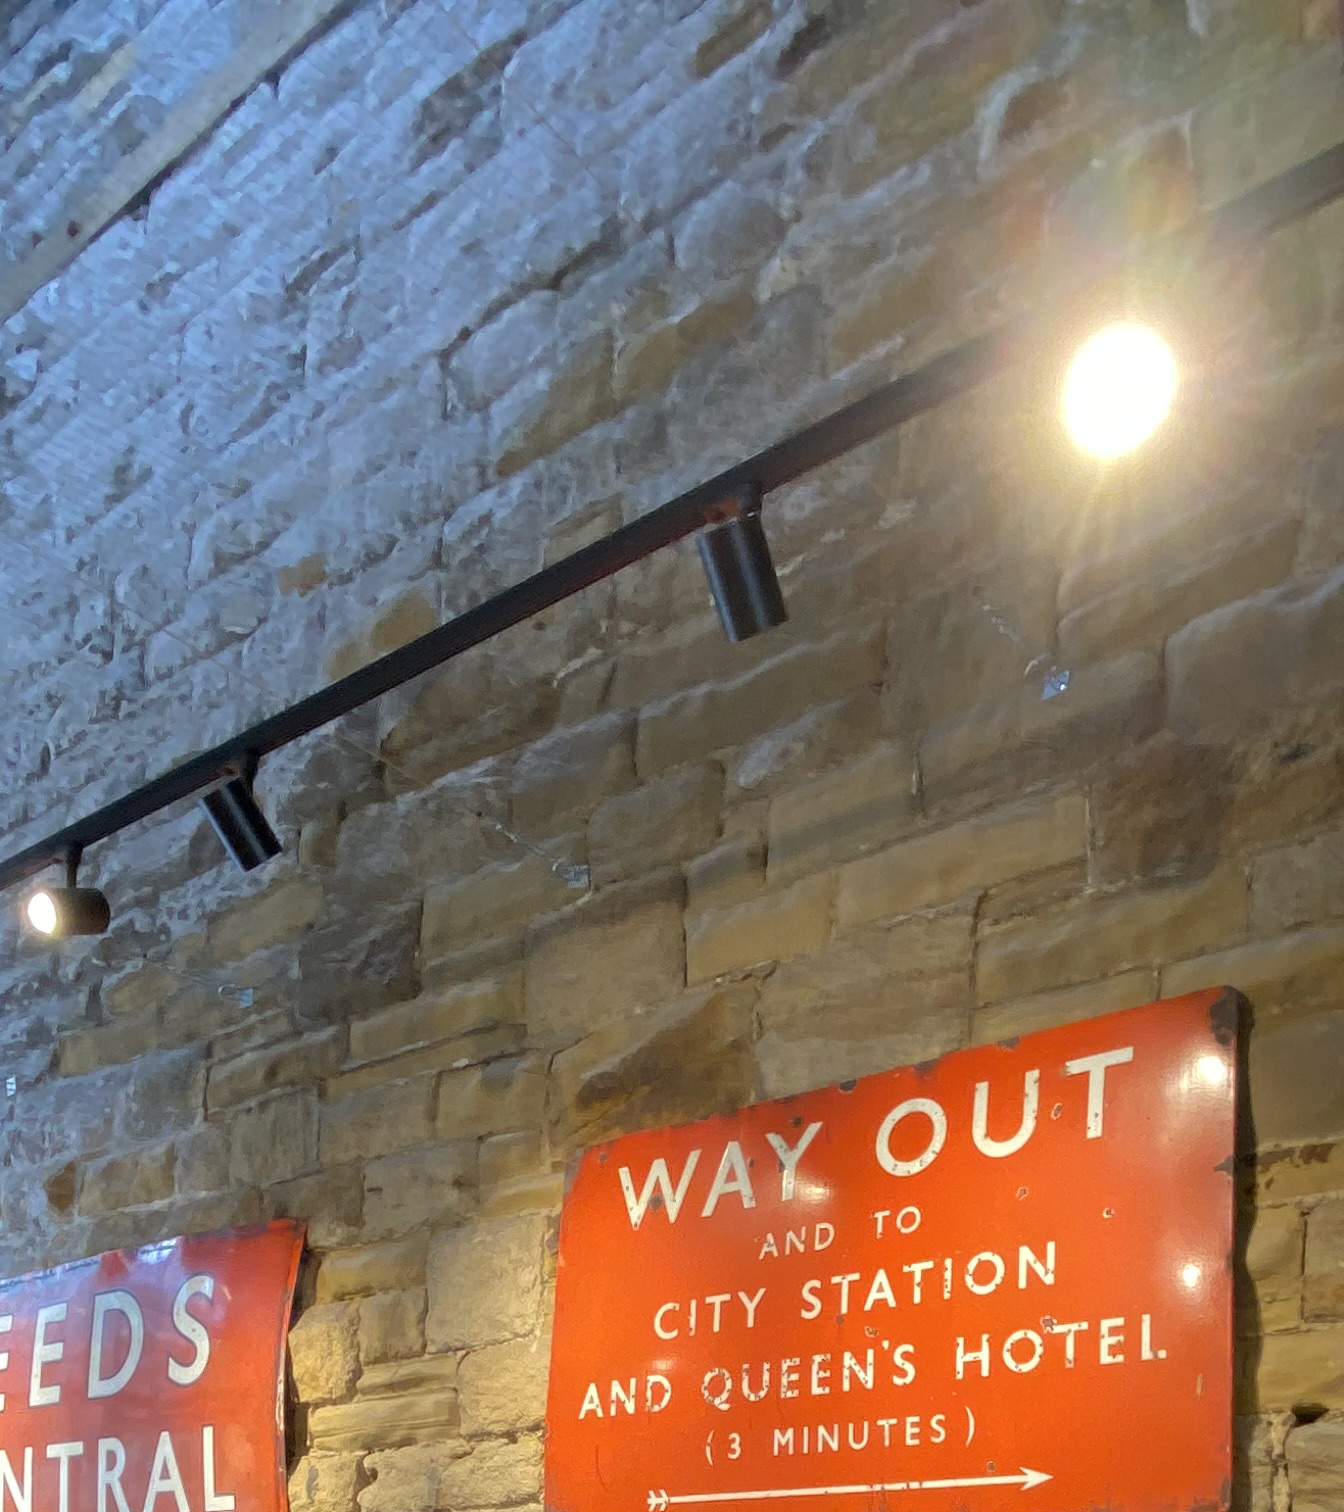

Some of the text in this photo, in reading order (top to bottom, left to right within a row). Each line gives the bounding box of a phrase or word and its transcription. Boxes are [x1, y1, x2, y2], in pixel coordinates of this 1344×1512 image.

[619, 1047, 1134, 1230] WAY OUT
[758, 1206, 921, 1260] AND TO
[654, 1241, 1056, 1340] CITY STATION
[579, 1375, 672, 1420] AND
[701, 1340, 916, 1410] QUEEN'S
